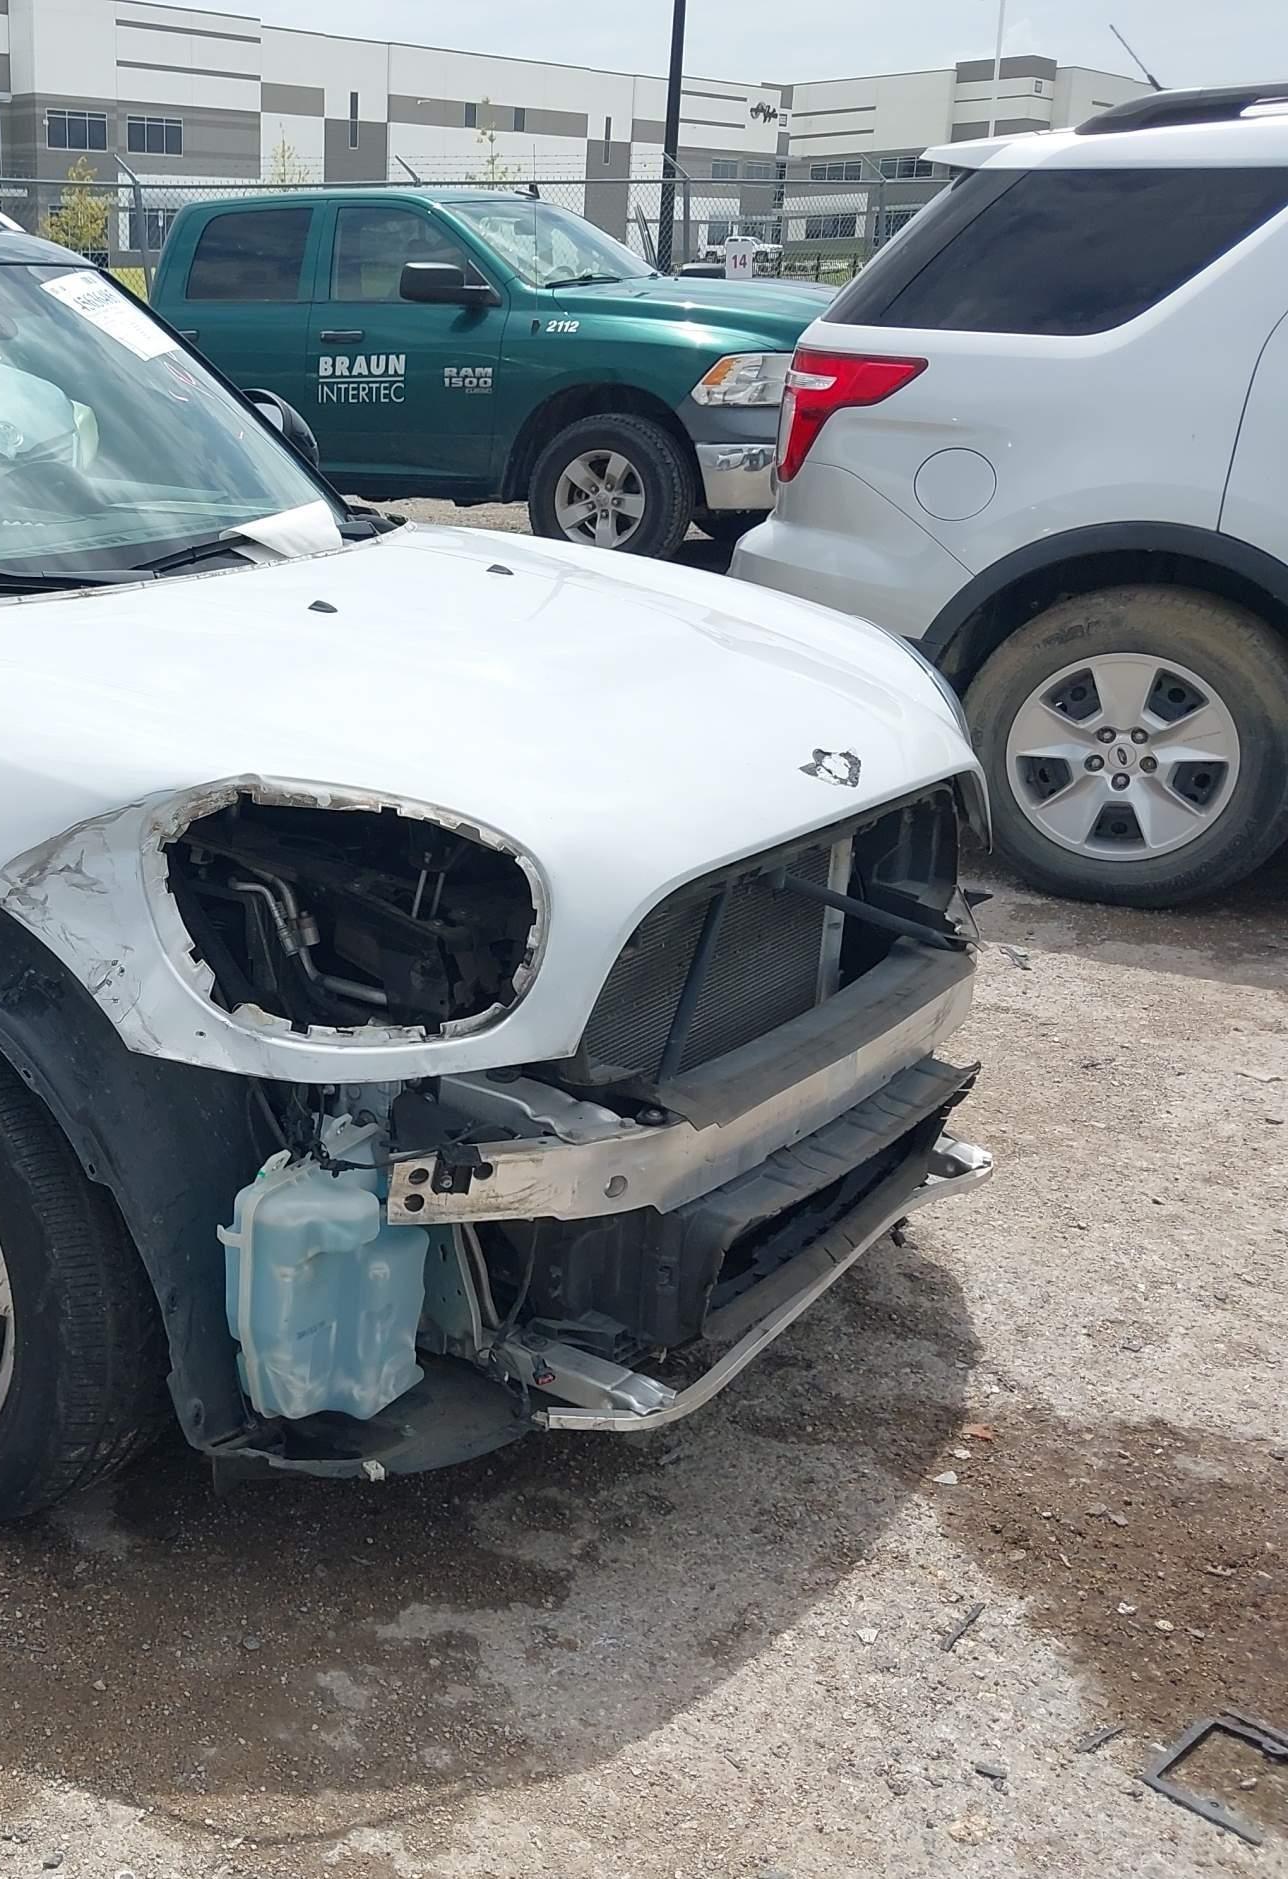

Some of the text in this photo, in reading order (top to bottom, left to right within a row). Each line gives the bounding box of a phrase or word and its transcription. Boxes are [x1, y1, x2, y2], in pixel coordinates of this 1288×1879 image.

[732, 254, 748, 269] 14
[546, 320, 580, 333] 2112
[318, 354, 406, 377] BRAUN
[444, 367, 493, 377] RAM
[444, 377, 492, 388] 1500
[318, 382, 405, 404] INTERTEC
